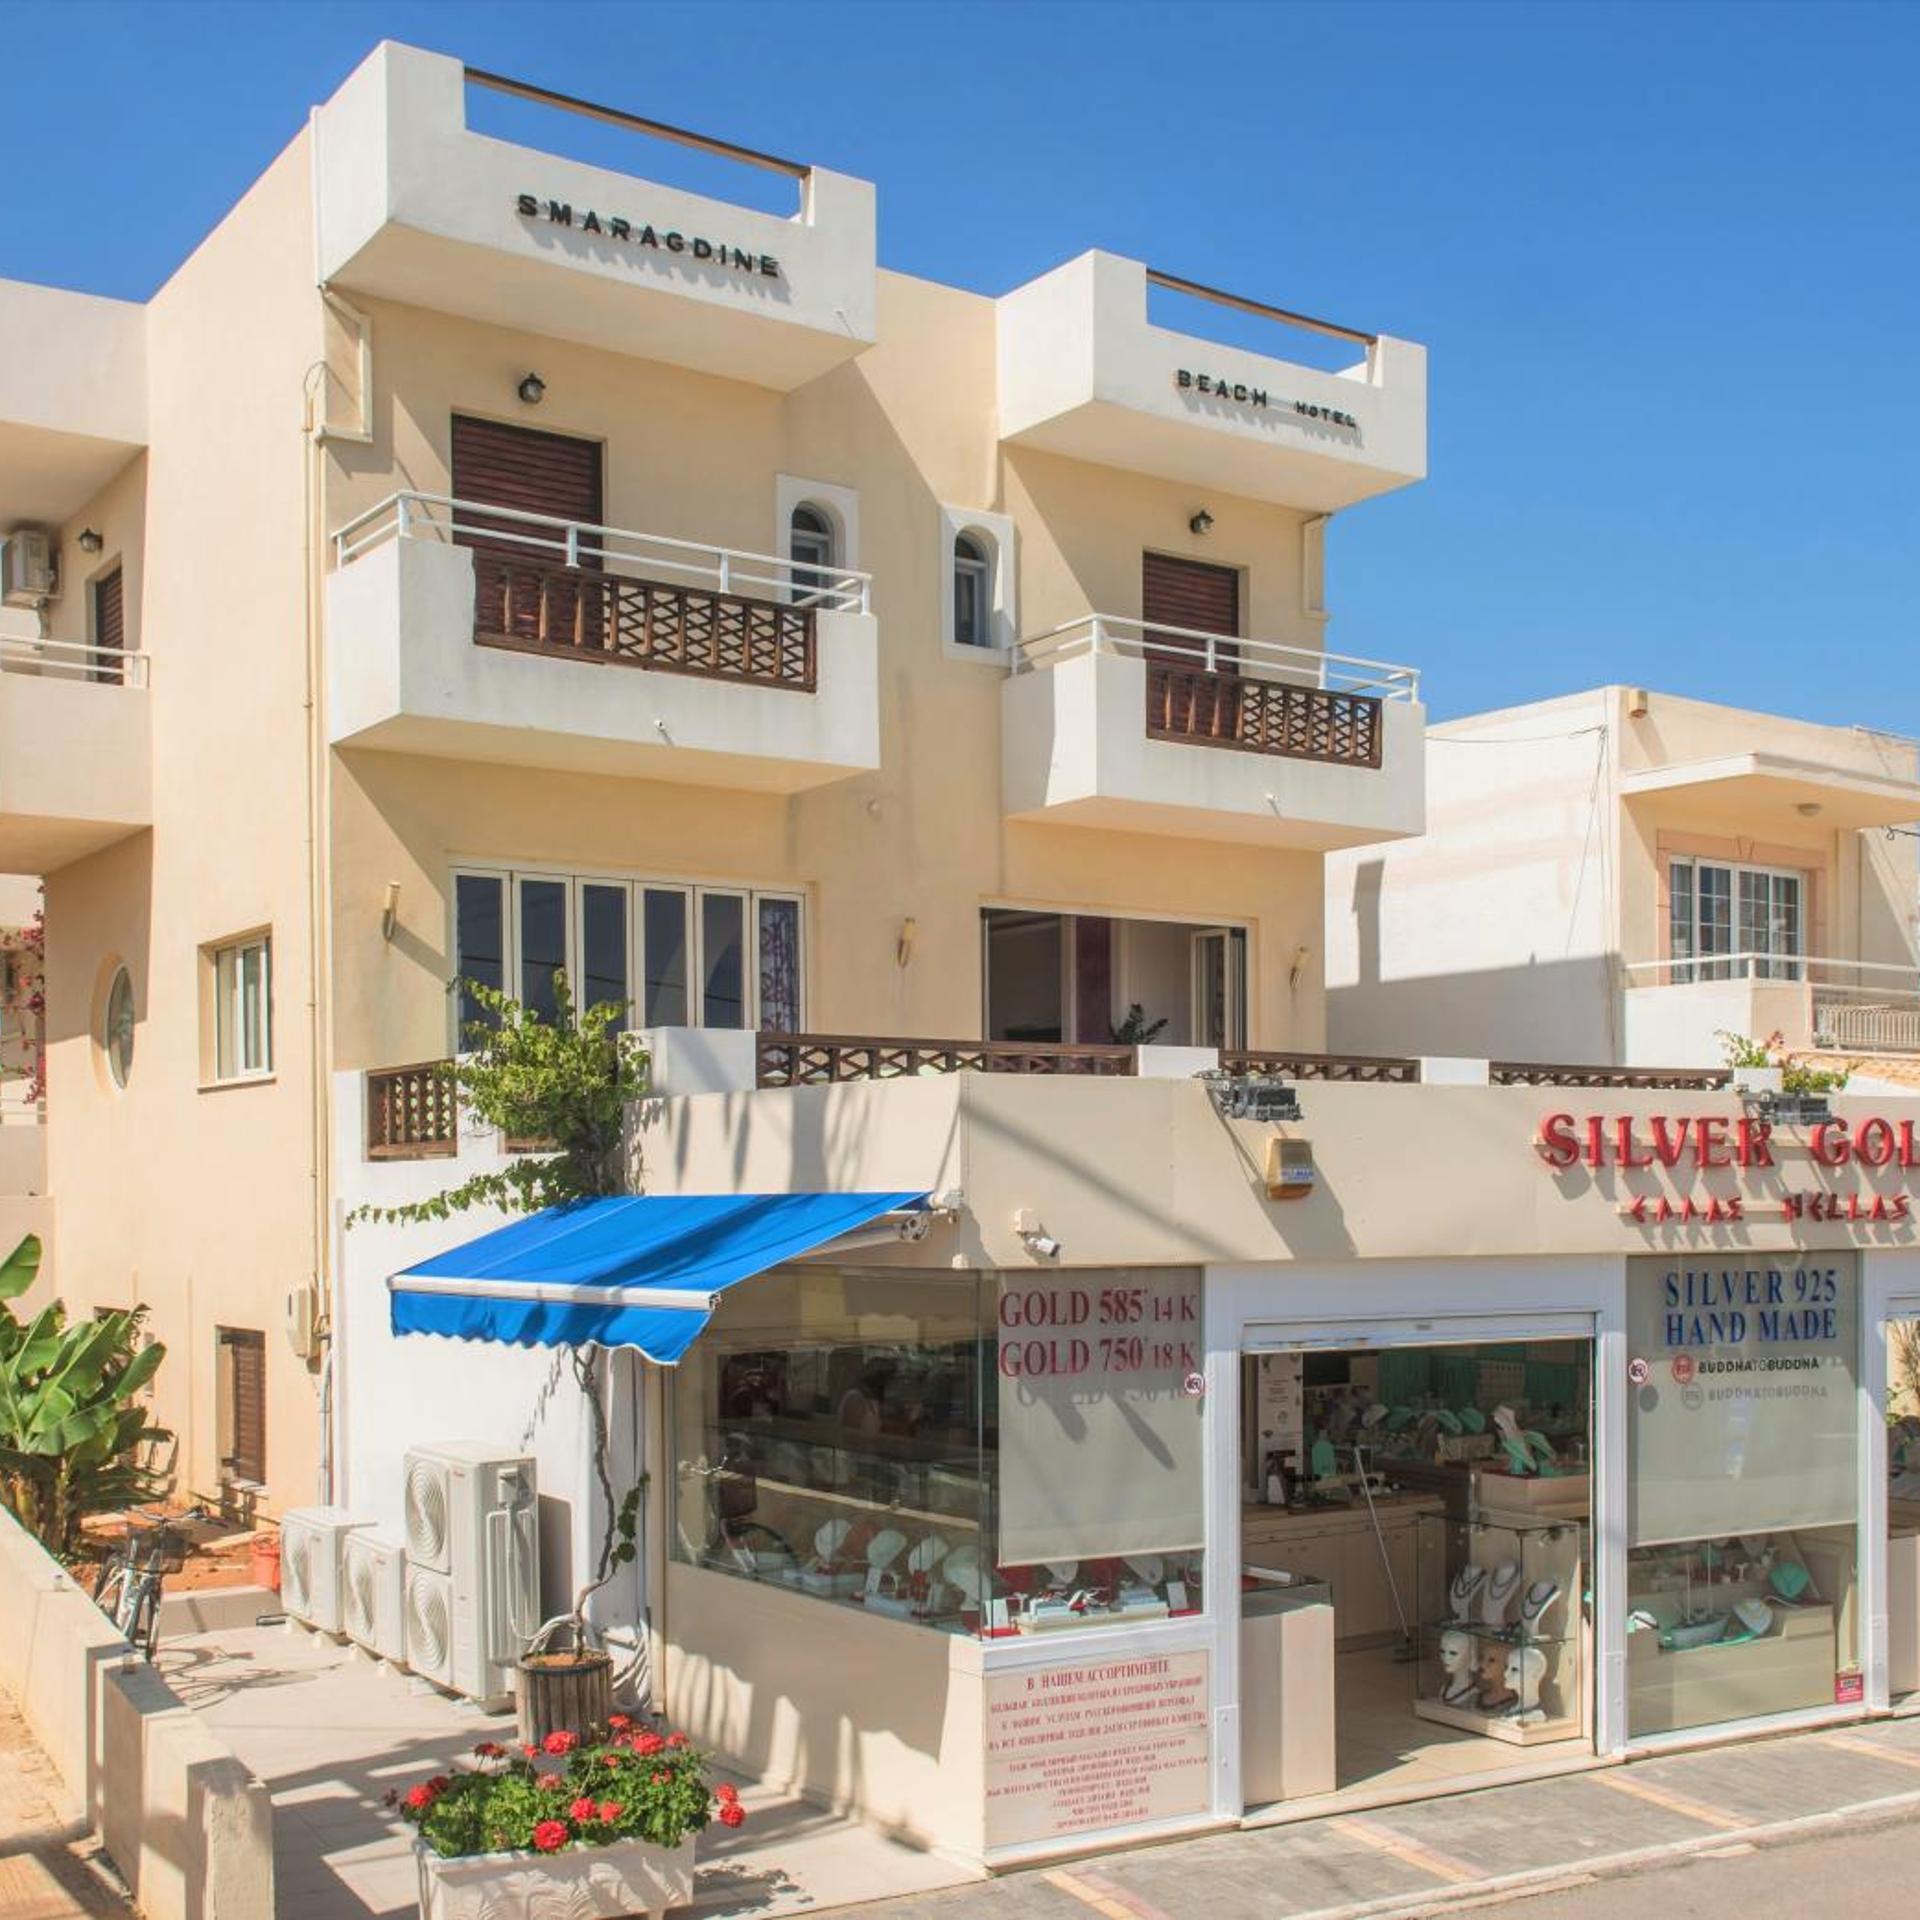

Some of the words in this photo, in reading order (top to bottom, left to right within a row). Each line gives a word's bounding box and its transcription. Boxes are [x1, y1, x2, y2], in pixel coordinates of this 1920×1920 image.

[517, 194, 779, 278] SMARAGDINE
[1177, 369, 1268, 408] BEACH
[1296, 400, 1357, 428] HOTEL
[1540, 1113, 1775, 1168] SILVER
[1782, 1192, 1909, 1223] HELLAS
[1665, 1270, 1785, 1308] SILVER
[1795, 1269, 1838, 1302] 925
[1000, 1290, 1090, 1328] GOLD
[1154, 1296, 1173, 1322] 14
[1181, 1294, 1197, 1321] K
[1665, 1311, 1746, 1347] HAND
[1760, 1308, 1838, 1343] MADE
[1000, 1339, 1090, 1378] GOLD
[1154, 1341, 1174, 1369] 18
[1181, 1340, 1197, 1370] K
